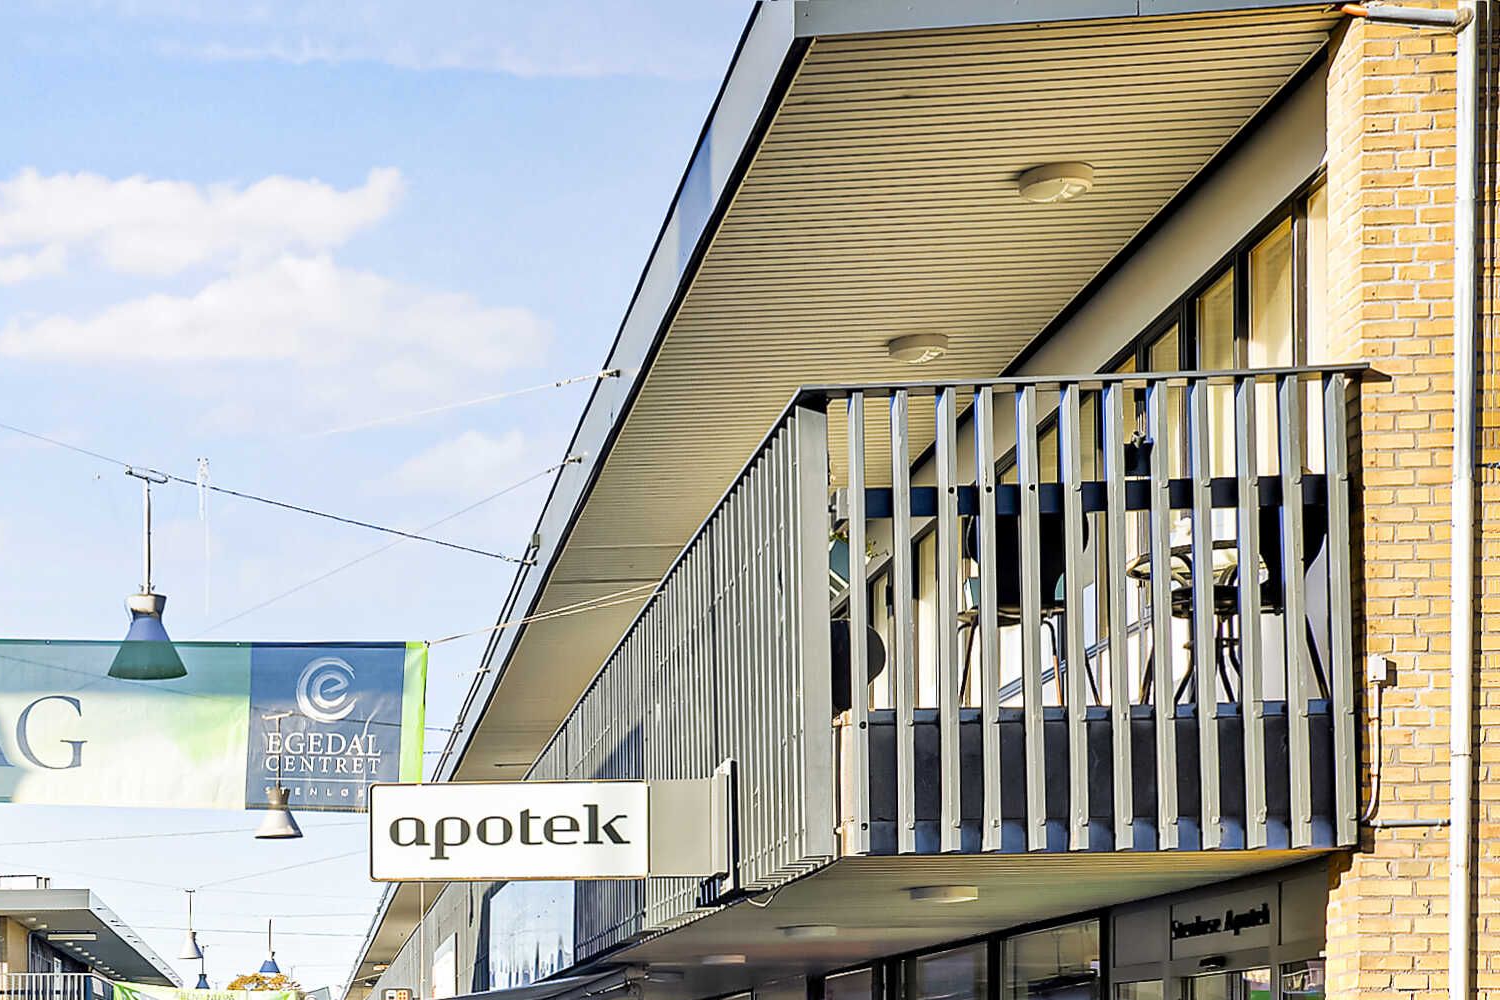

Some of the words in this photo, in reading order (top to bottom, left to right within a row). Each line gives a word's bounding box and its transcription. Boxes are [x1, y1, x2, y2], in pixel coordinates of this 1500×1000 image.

[265, 732, 382, 756] EGEDAL
[265, 756, 381, 774] CENTRET
[389, 804, 631, 860] apotek
